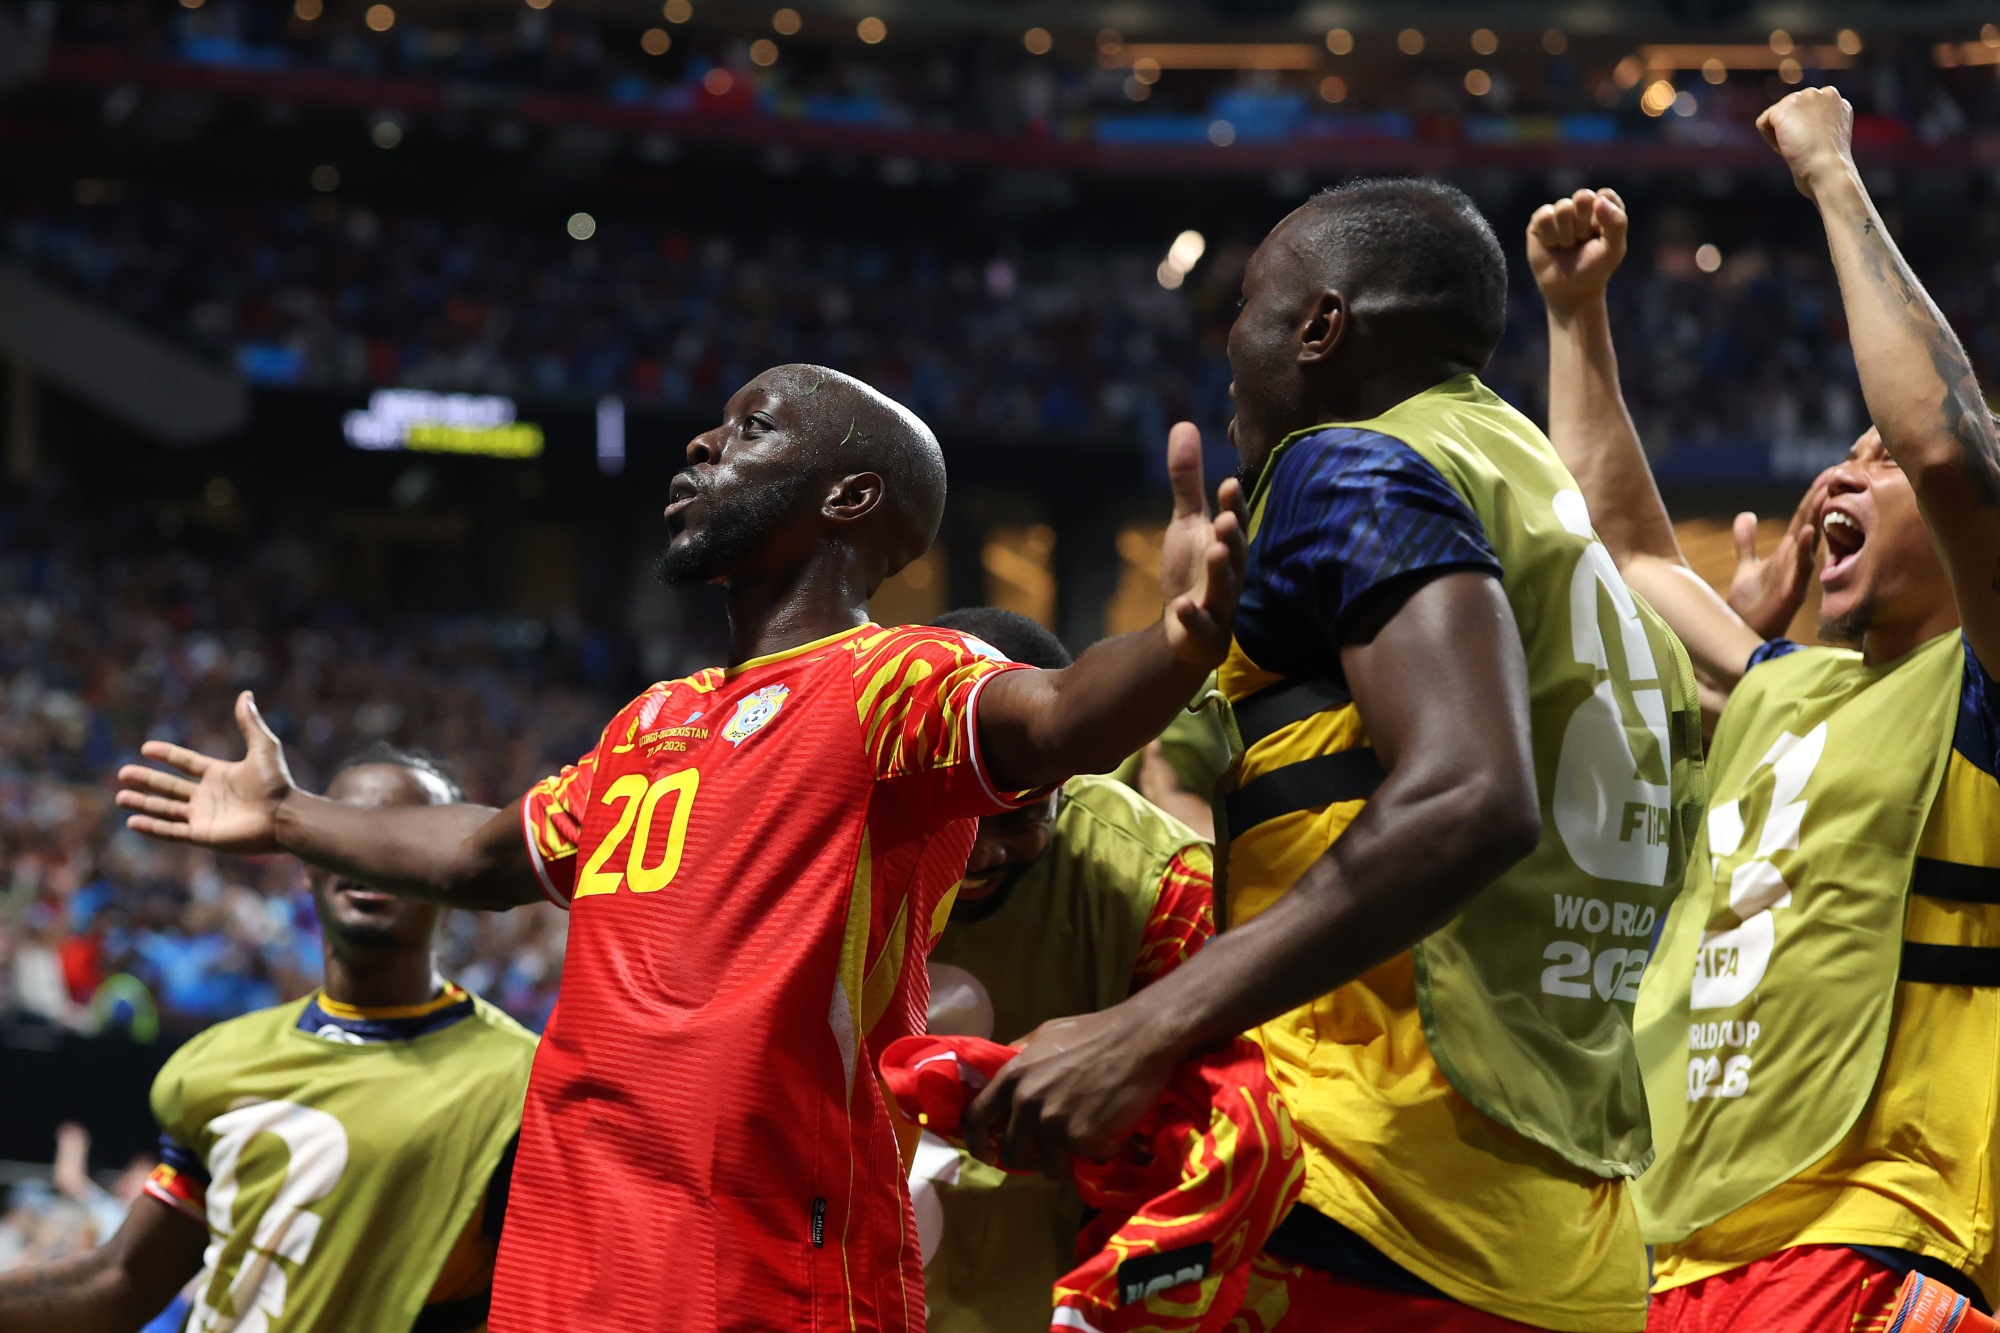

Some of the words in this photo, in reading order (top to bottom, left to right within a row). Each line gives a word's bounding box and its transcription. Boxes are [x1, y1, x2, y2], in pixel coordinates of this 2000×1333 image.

[662, 740, 687, 752] 2026
[574, 767, 700, 900] 20
[1553, 893, 1656, 938] WORLD
[1541, 940, 1649, 1004] 202
[1688, 1022, 1719, 1050] RLD
[1718, 1020, 1761, 1048] CUP
[1687, 1054, 1753, 1103] 026
[1912, 1285, 1938, 1325] FAYULU
